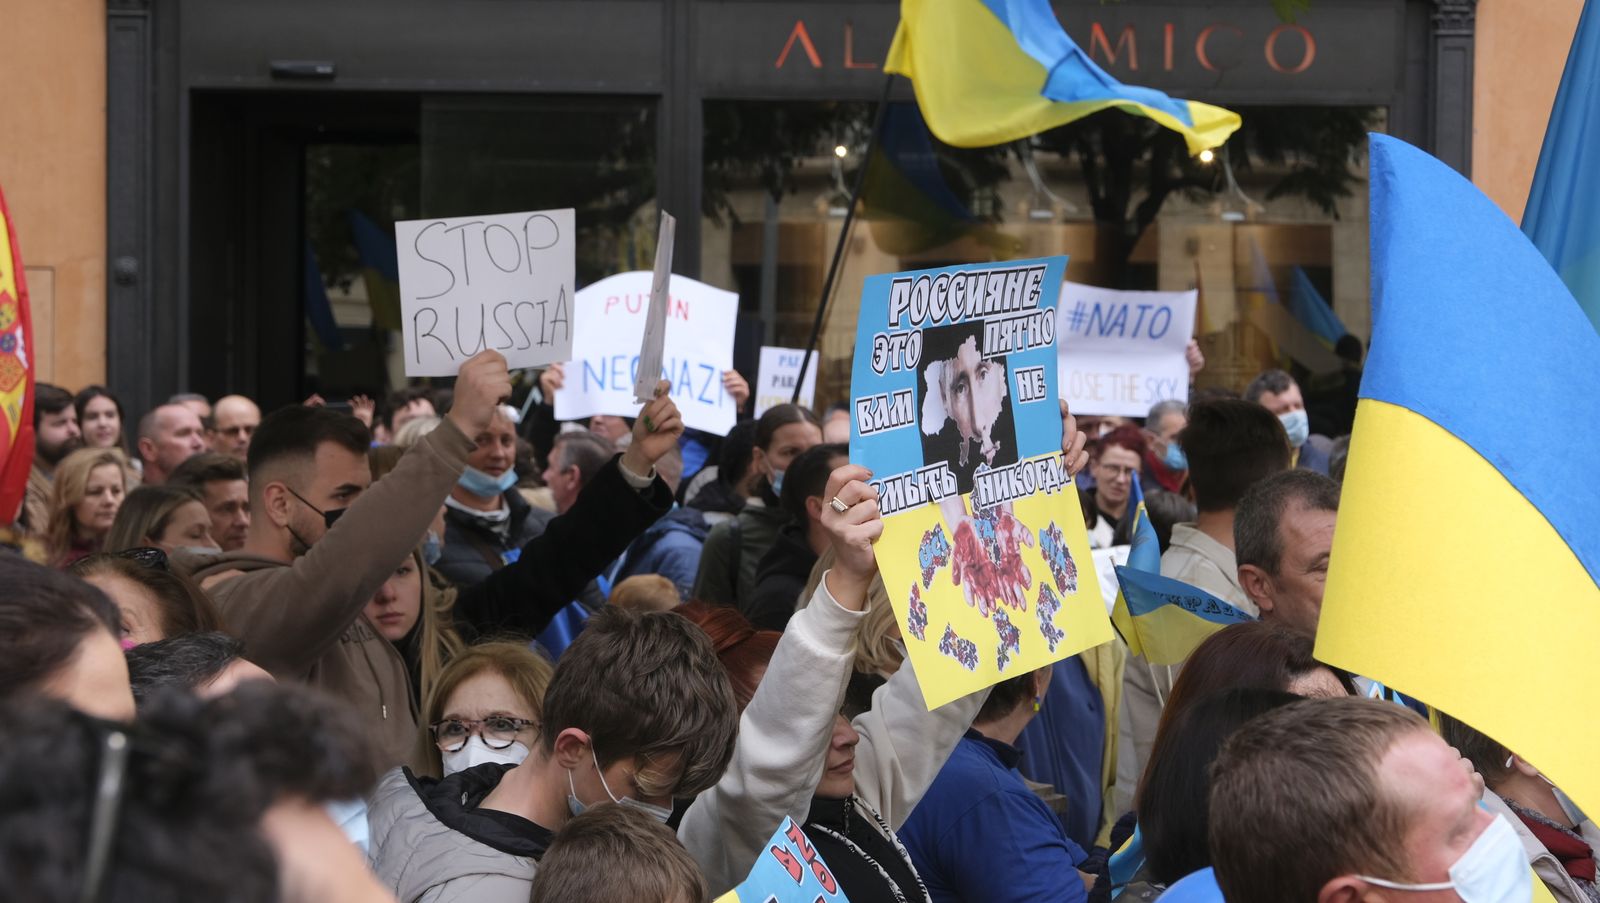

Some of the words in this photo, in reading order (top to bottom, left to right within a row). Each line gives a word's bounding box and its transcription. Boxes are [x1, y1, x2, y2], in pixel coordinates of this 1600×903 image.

[414, 213, 560, 300] STOP
[413, 283, 569, 364] RUSSIA
[604, 294, 690, 322] PUIN
[888, 265, 1048, 329] РОССИЯНЕ
[1066, 301, 1173, 340] #NATO
[871, 329, 923, 375] ЭТО
[983, 307, 1056, 357] ПЯТНО
[856, 390, 914, 435] ВАМ
[1015, 367, 1046, 402] НЕ
[1107, 372, 1141, 404] THE
[1144, 375, 1179, 404] SKY
